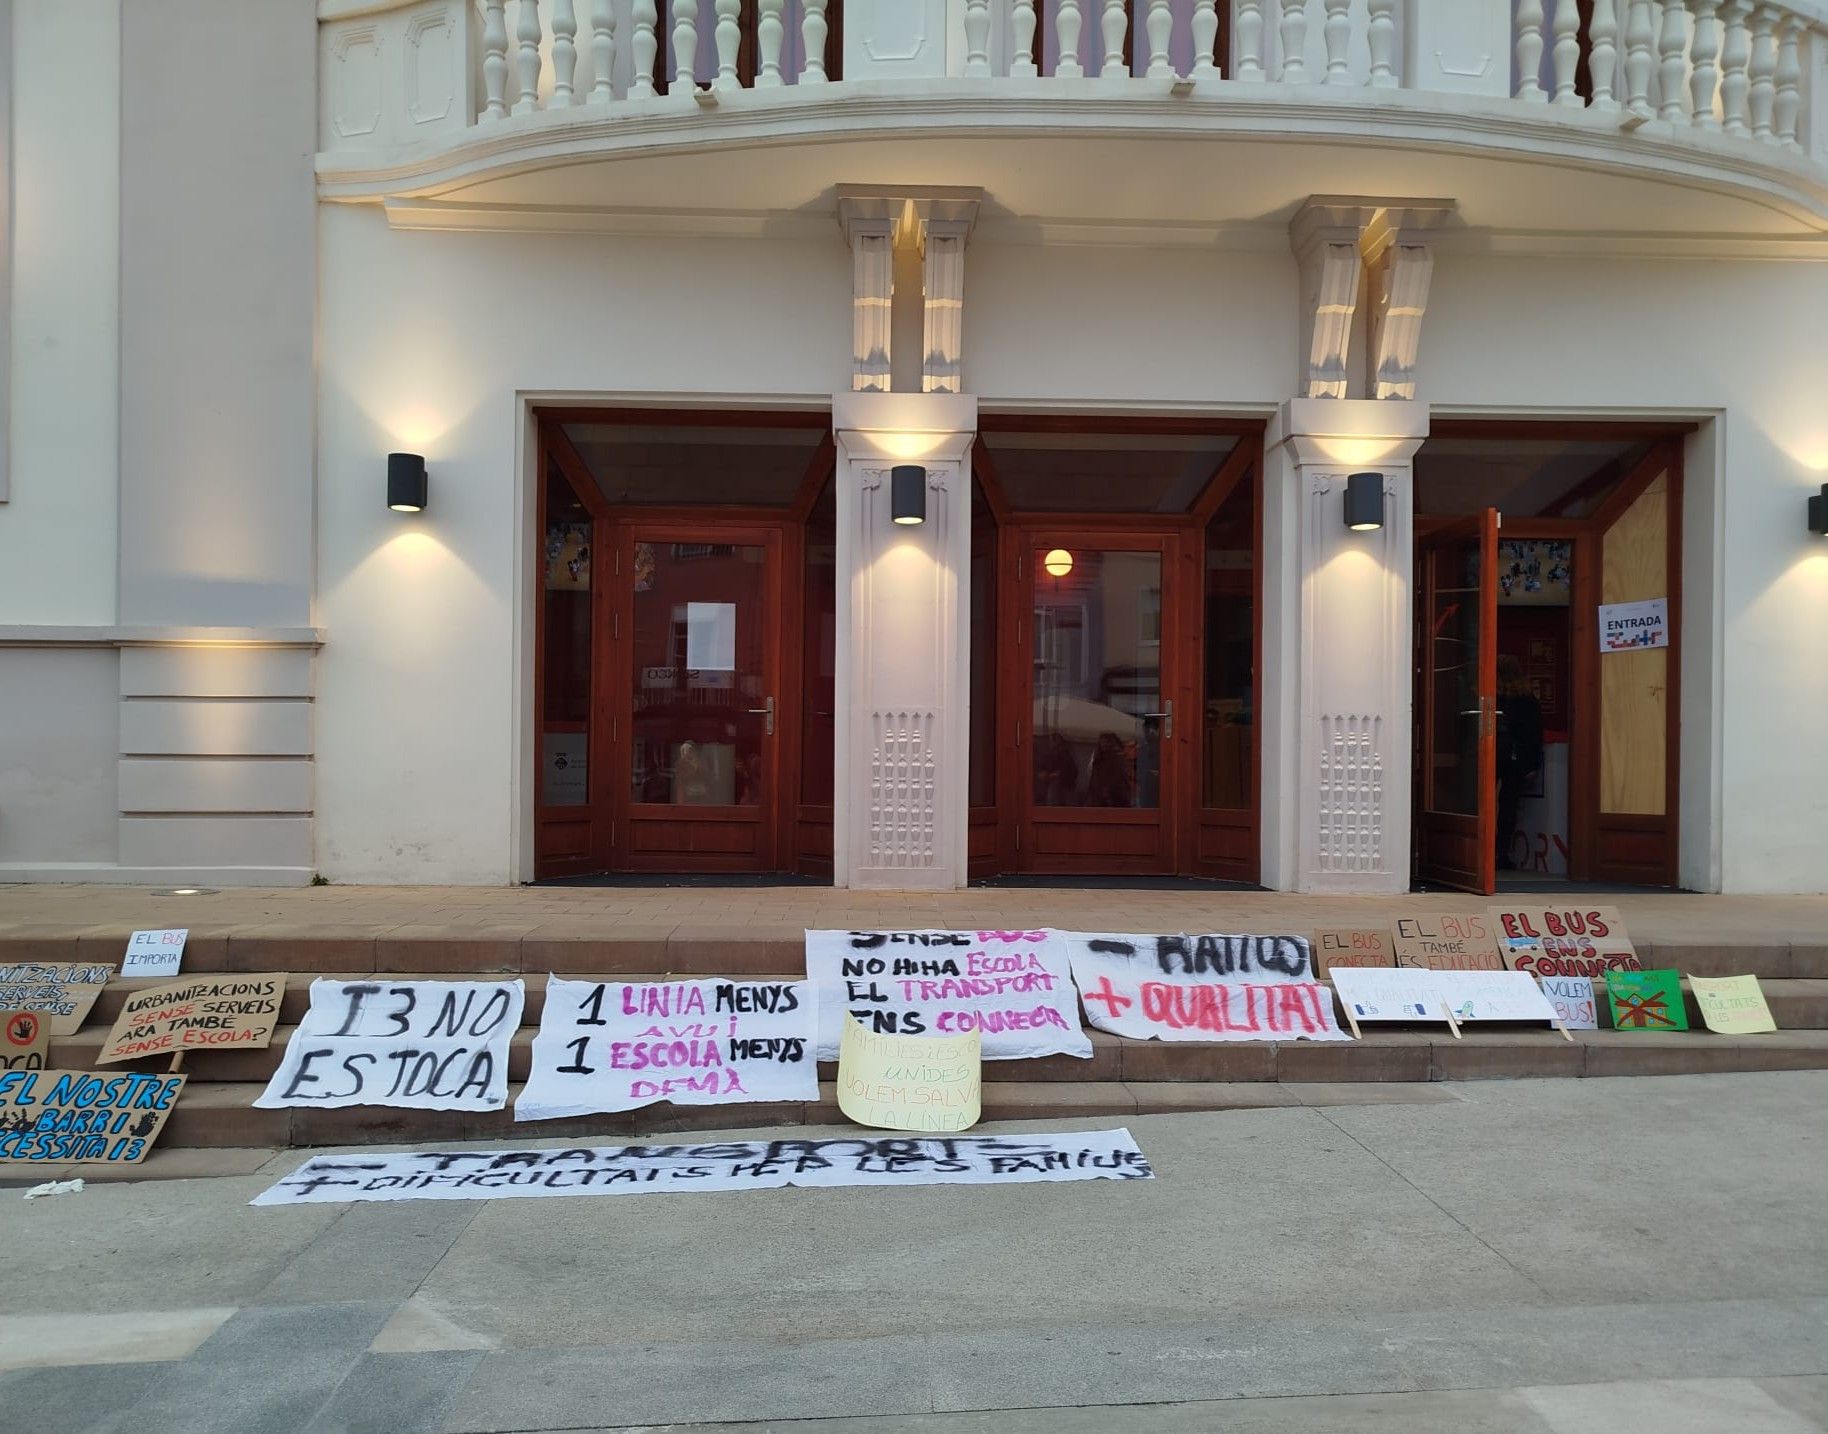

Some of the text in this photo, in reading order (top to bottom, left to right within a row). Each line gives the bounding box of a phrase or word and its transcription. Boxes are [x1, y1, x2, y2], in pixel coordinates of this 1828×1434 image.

[1607, 615, 1662, 630] ENTRADA
[1398, 916, 1486, 939] EL BUS
[1501, 911, 1609, 938] EL BUS
[135, 933, 185, 945] EL BUS
[1323, 932, 1381, 950] EL BUS
[1420, 940, 1466, 954] TAMBÉ
[1542, 937, 1597, 958] ENS
[127, 953, 178, 965] IMPORTA
[842, 957, 886, 977] NO
[966, 951, 1047, 976] ESCOLA
[1400, 950, 1423, 968] ÉS
[127, 981, 275, 1013] URBANITZACIONS
[847, 972, 1059, 1001] EL TRANSPORT
[1545, 981, 1592, 998] VOLEM
[129, 998, 275, 1027] SENSE SERVEIS
[424, 987, 511, 1037] NO
[576, 984, 799, 1025] 1 LINIA MENYS
[1556, 1001, 1596, 1024] BUS!
[117, 1014, 237, 1043] ARA TAMBÉ
[110, 1028, 268, 1056] SENSE ESCOLA?
[556, 1036, 807, 1074] 1 ESCOLA MENYS
[385, 1048, 494, 1099] TOCA
[0, 1071, 182, 1110] EL NOSTRE
[35, 1108, 131, 1134] BARRI
